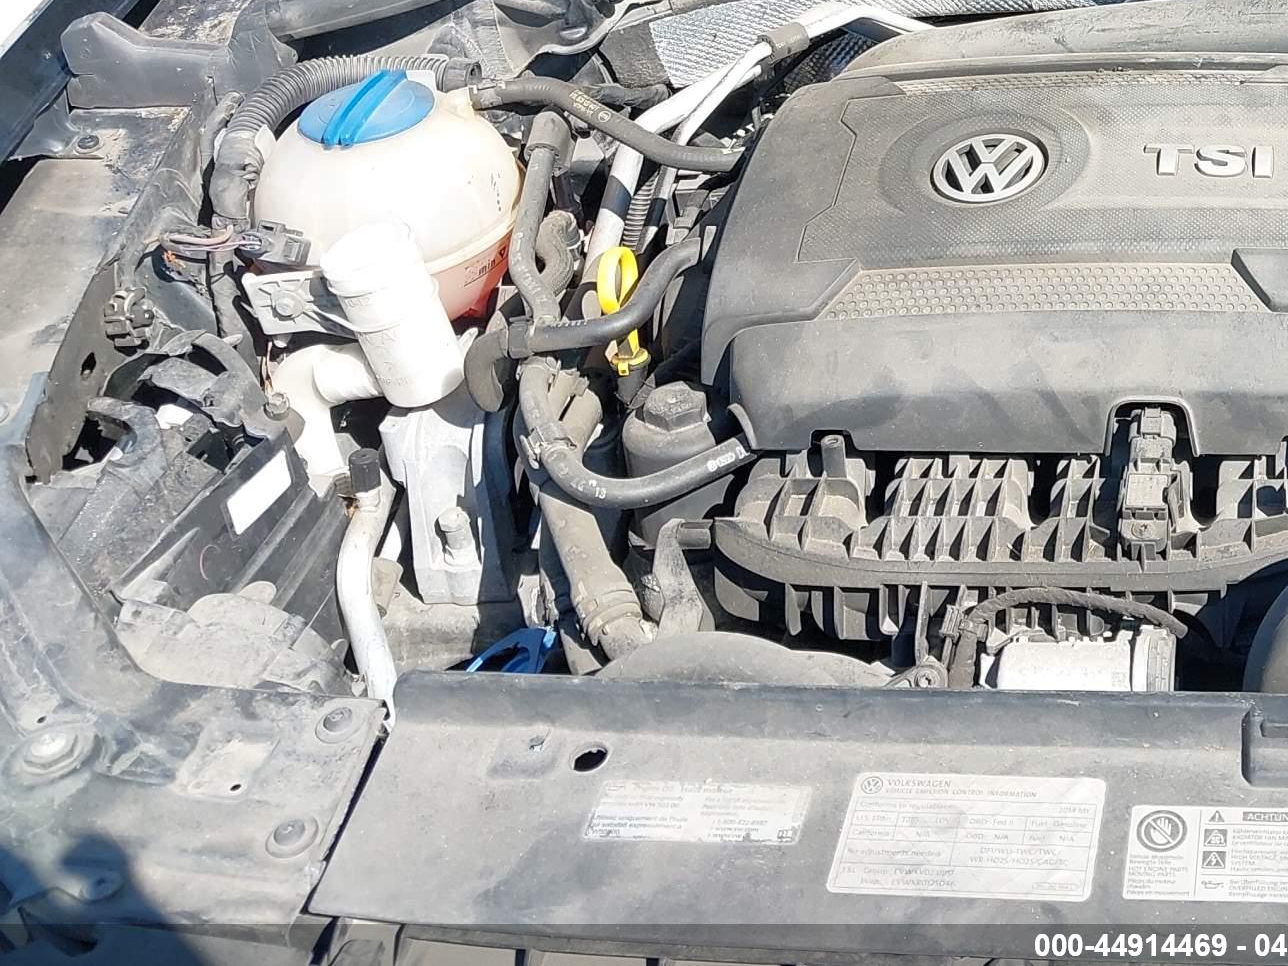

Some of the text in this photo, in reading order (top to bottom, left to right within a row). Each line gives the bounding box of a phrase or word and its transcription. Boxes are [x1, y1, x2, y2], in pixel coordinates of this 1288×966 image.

[1143, 143, 1275, 179] TSI
[477, 258, 497, 276] min
[886, 778, 953, 788] VOLKSWAGEN
[987, 790, 1038, 798] INFORMATION
